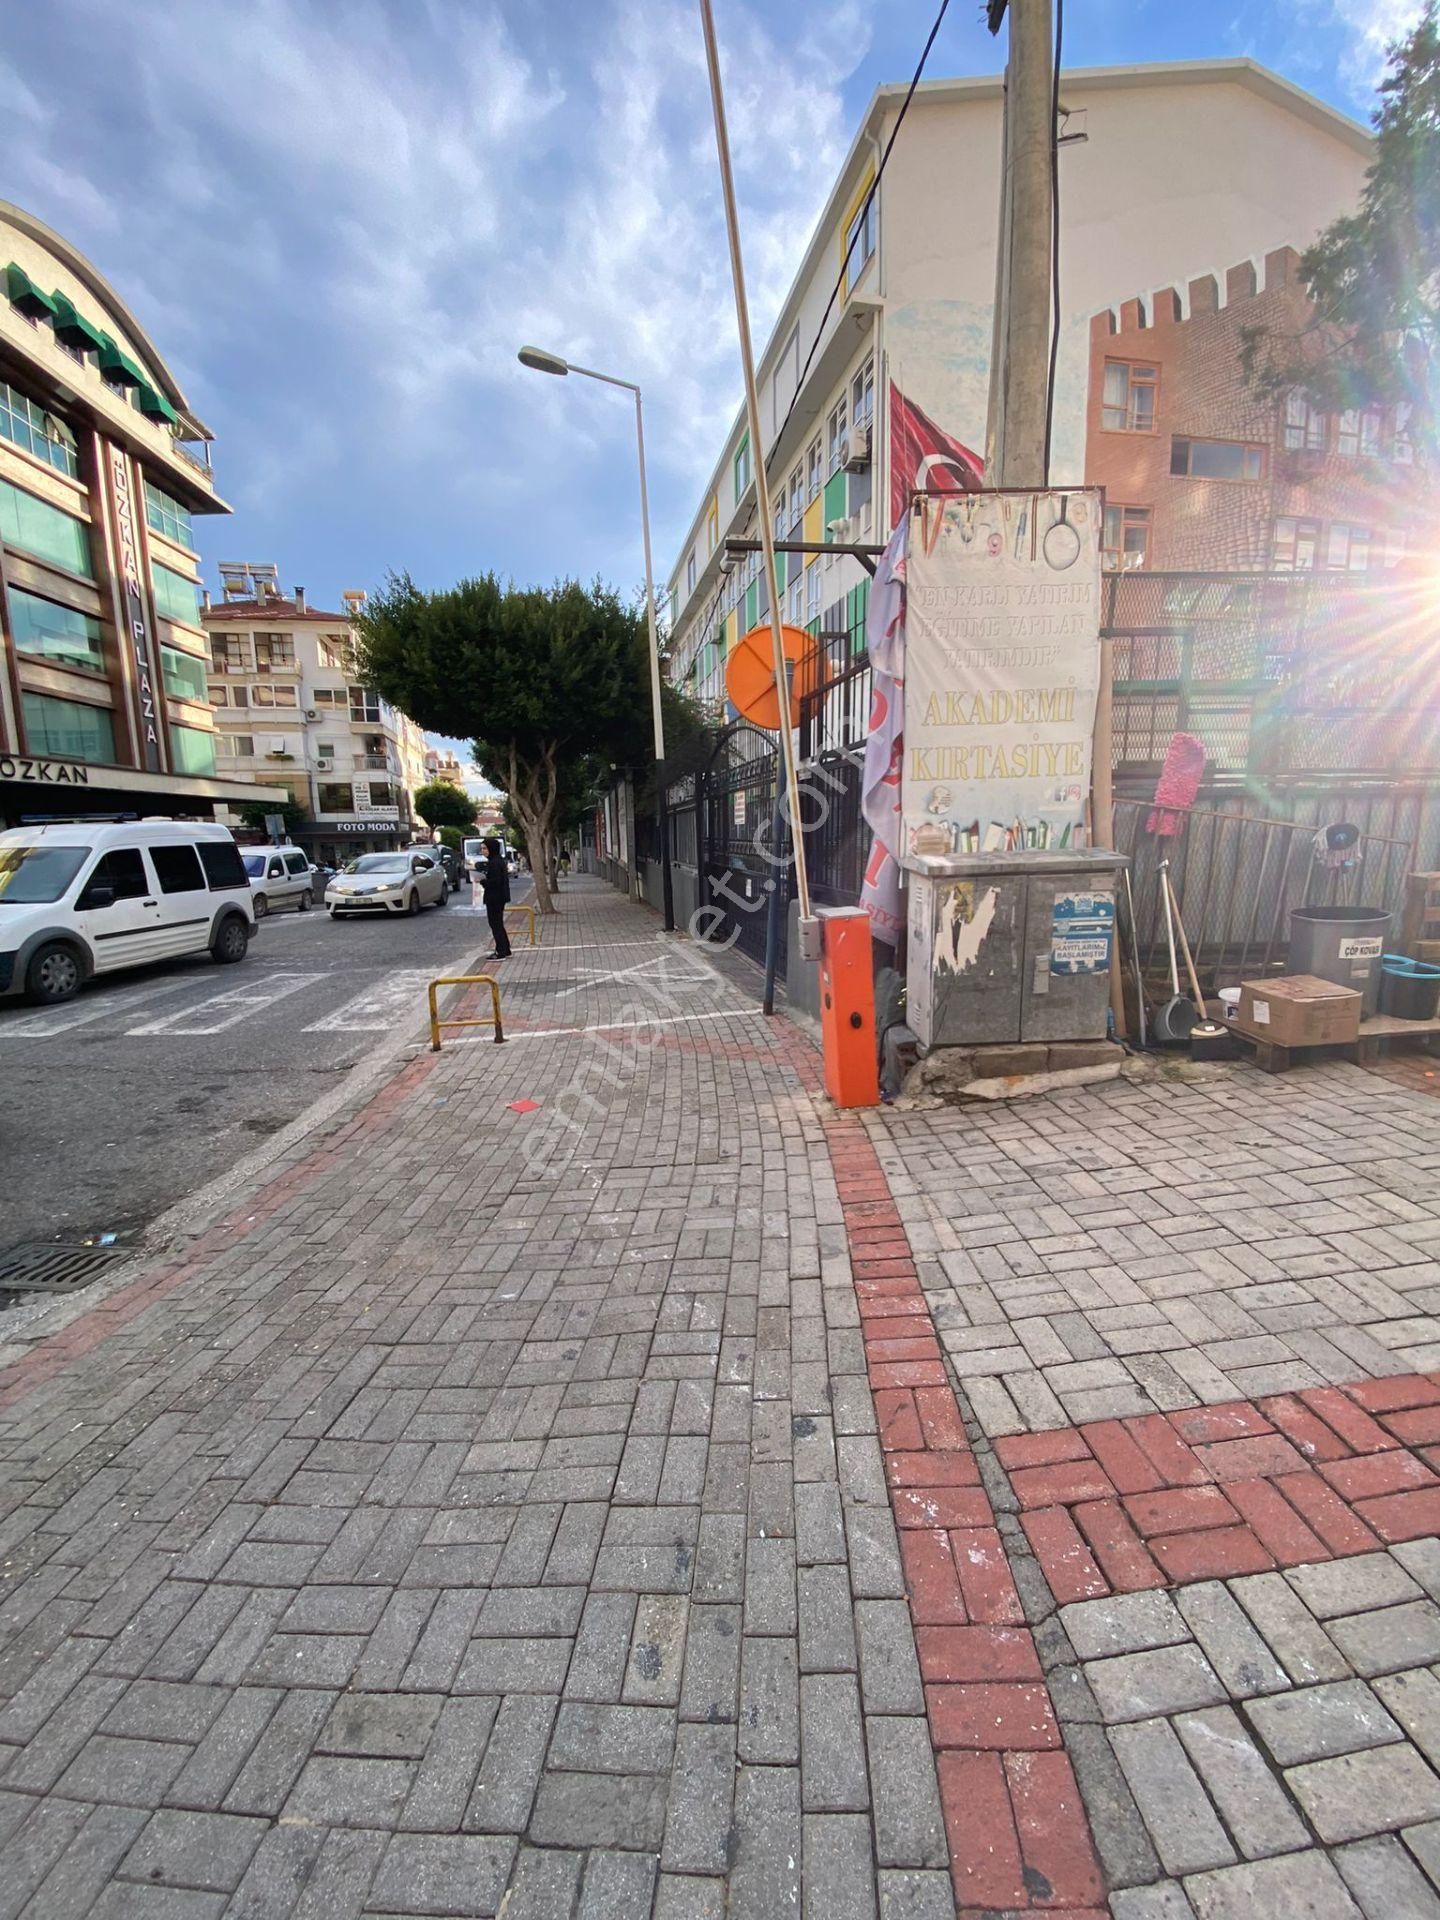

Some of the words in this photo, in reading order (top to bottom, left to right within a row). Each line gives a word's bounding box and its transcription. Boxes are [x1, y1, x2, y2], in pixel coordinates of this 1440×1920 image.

[133, 620, 157, 744] PLAZA
[921, 675, 1078, 727] AKADEMİ
[909, 732, 1085, 782] KIRTASİYE
[337, 823, 365, 832] FOTO
[367, 823, 396, 832] MODA
